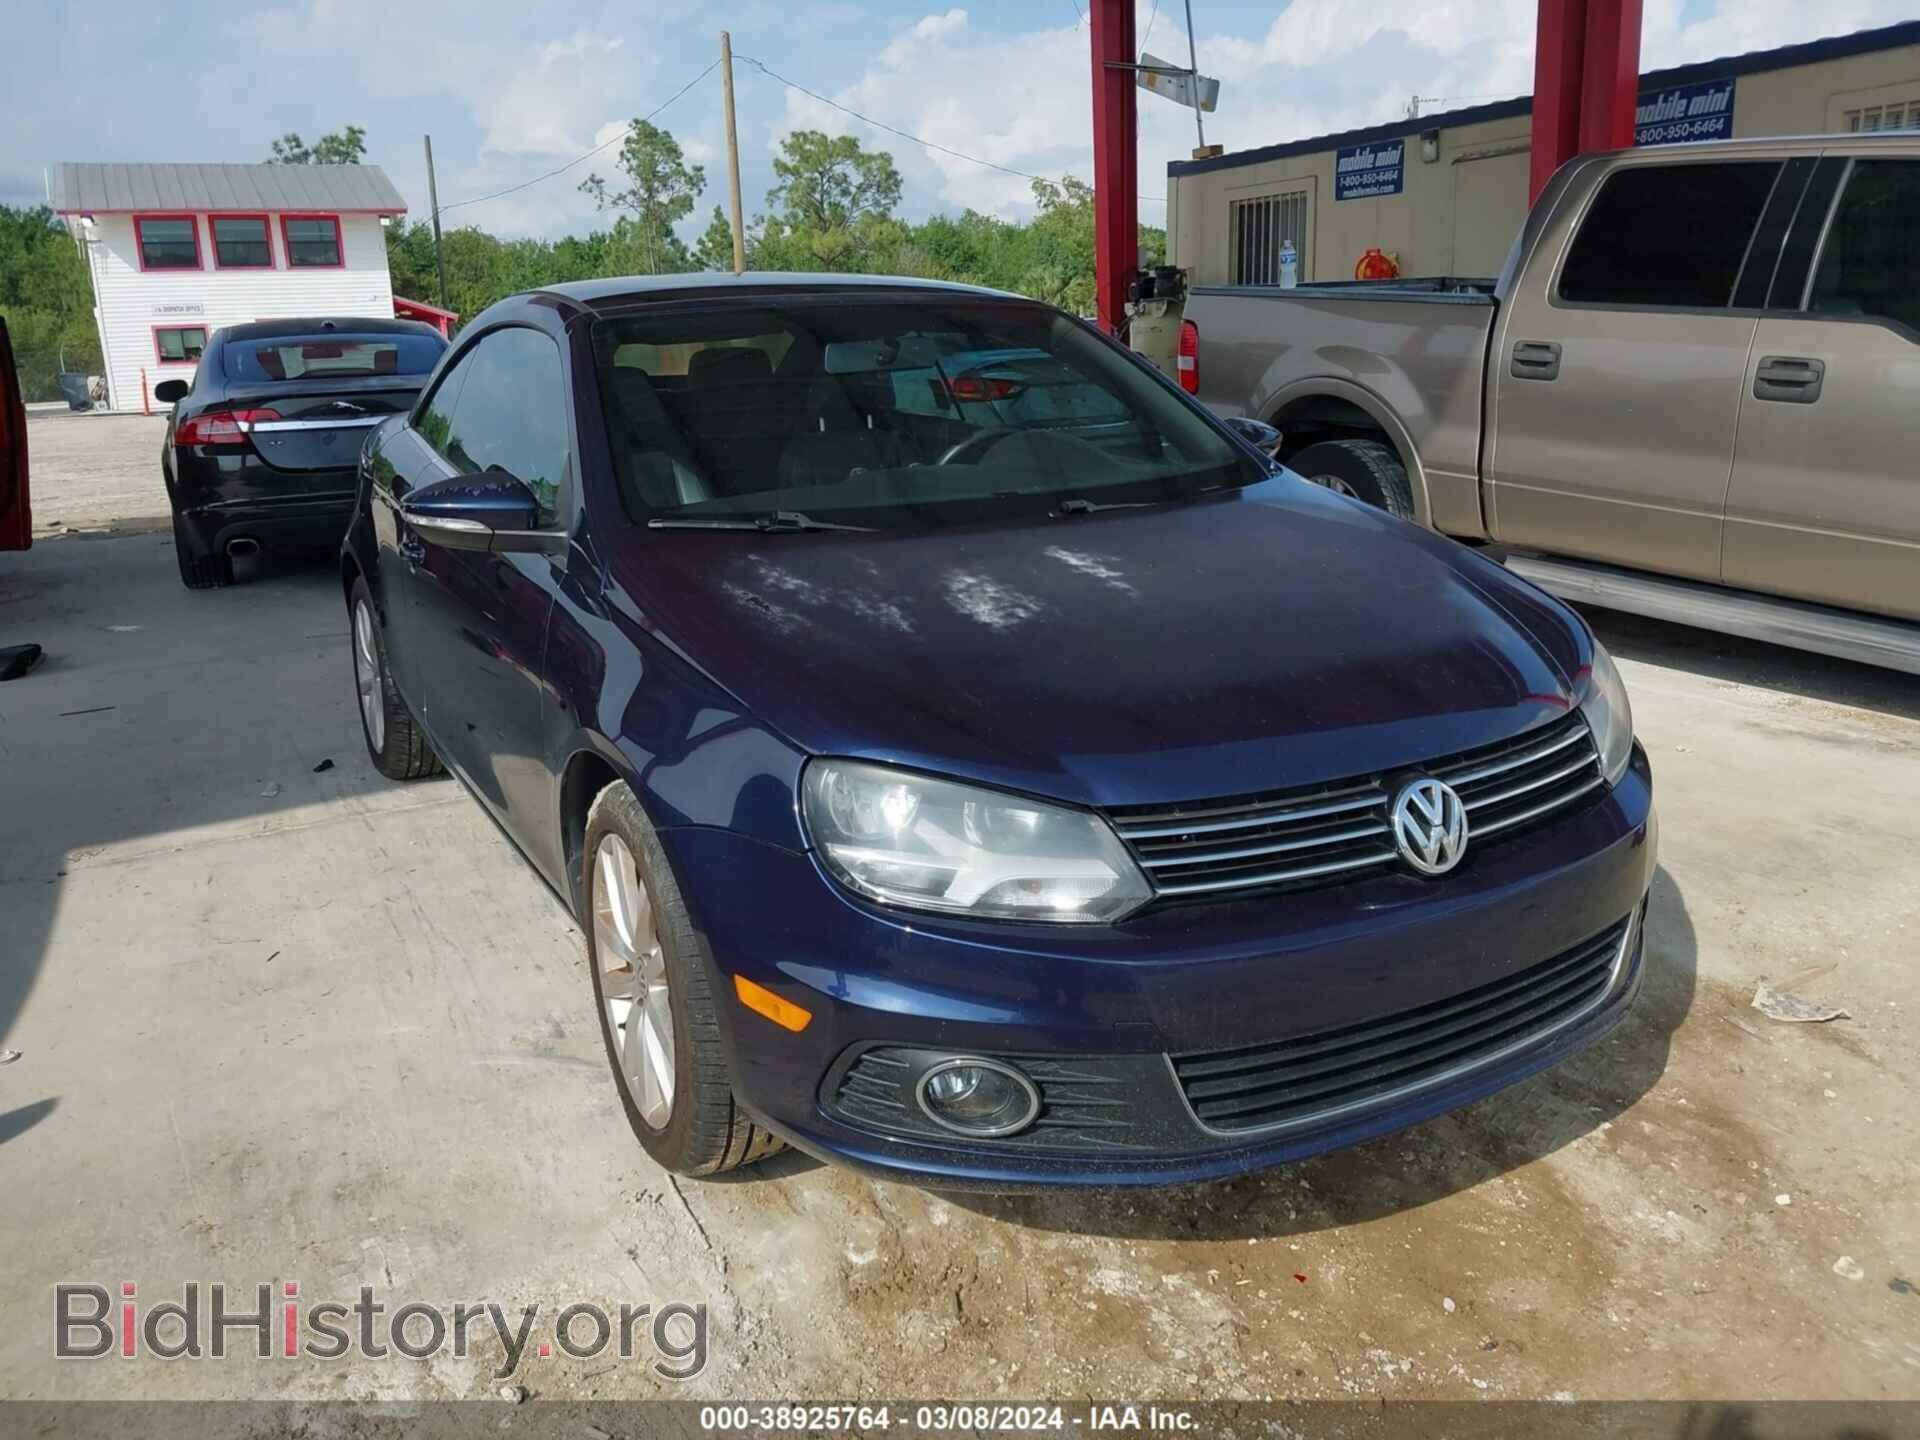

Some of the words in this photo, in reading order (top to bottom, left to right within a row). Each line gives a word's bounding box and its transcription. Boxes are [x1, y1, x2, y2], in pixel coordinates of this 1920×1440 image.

[1687, 86, 1732, 115] mini
[1338, 147, 1375, 172] mobile
[1375, 144, 1403, 167] mini
